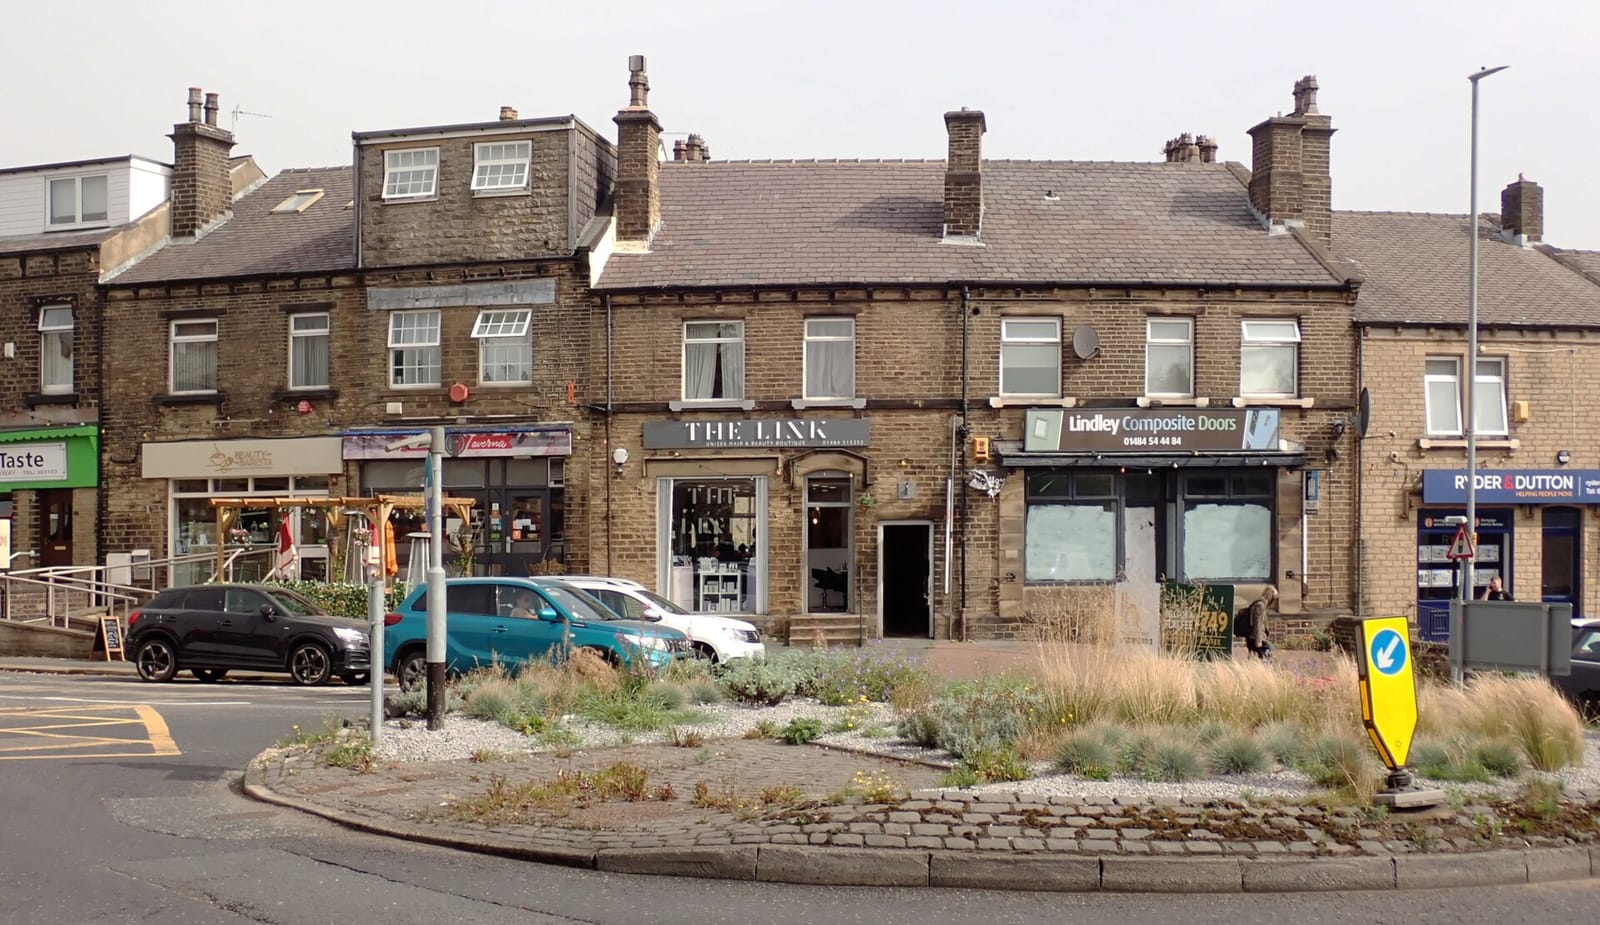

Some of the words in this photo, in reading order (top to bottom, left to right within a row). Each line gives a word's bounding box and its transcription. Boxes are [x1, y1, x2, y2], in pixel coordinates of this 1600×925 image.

[685, 422, 741, 440] THE
[757, 421, 827, 439] LINK
[1069, 414, 1120, 435] Lindley
[1122, 414, 1195, 434] Composite
[1198, 415, 1237, 431] Doors
[1123, 437, 1147, 446] 01484
[1148, 437, 1158, 445] 54
[1160, 437, 1170, 445] 44
[1171, 437, 1182, 445] 84
[0, 452, 44, 468] Taste
[1504, 474, 1514, 490] &
[1515, 475, 1574, 490] DUTTON
